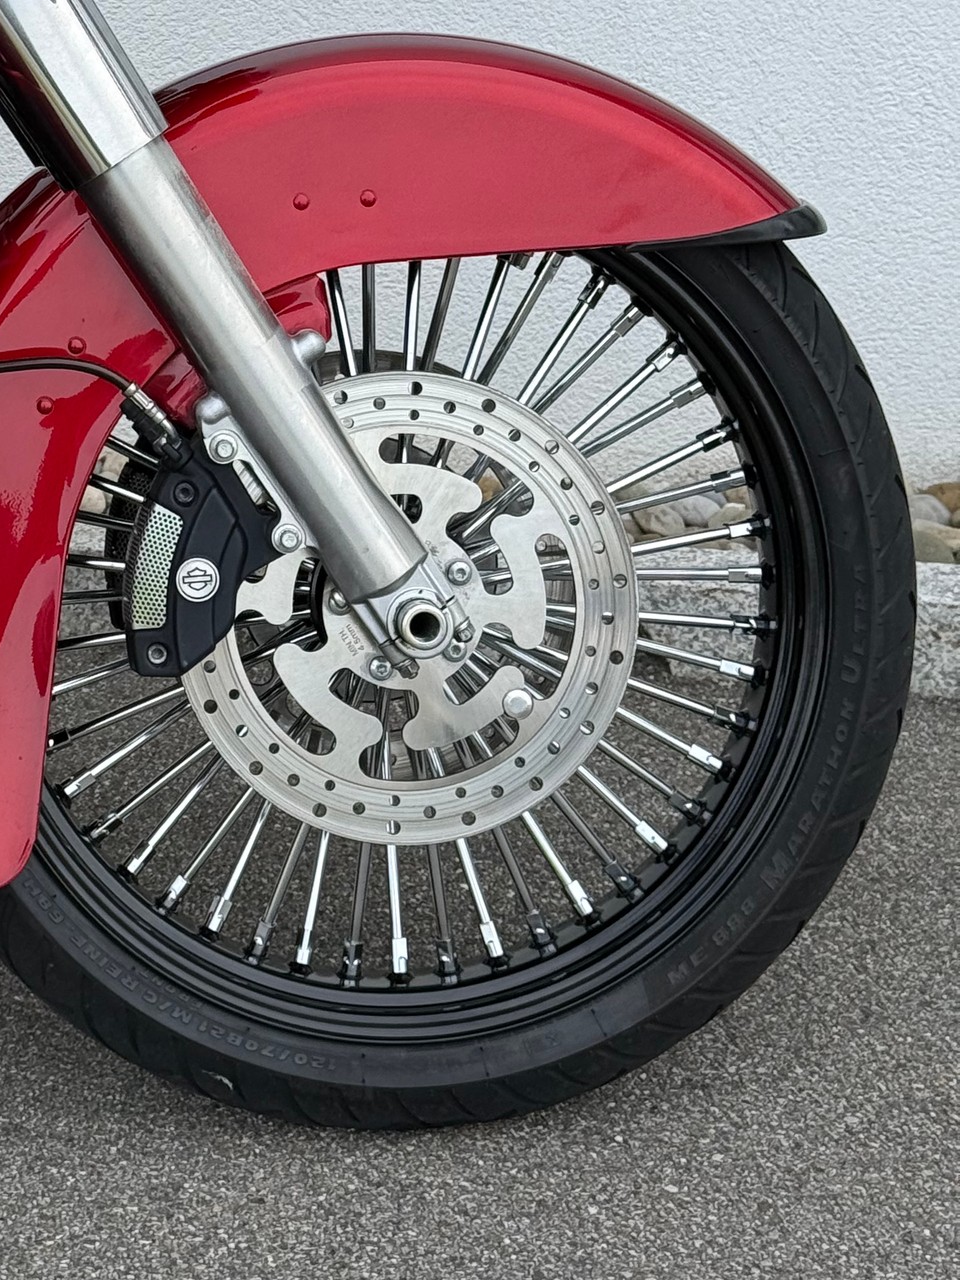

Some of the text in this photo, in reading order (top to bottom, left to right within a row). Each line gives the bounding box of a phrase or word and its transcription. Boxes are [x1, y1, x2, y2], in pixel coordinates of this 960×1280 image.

[667, 944, 708, 985] ME
[712, 894, 756, 947] 888
[142, 989, 193, 1025] M/C
